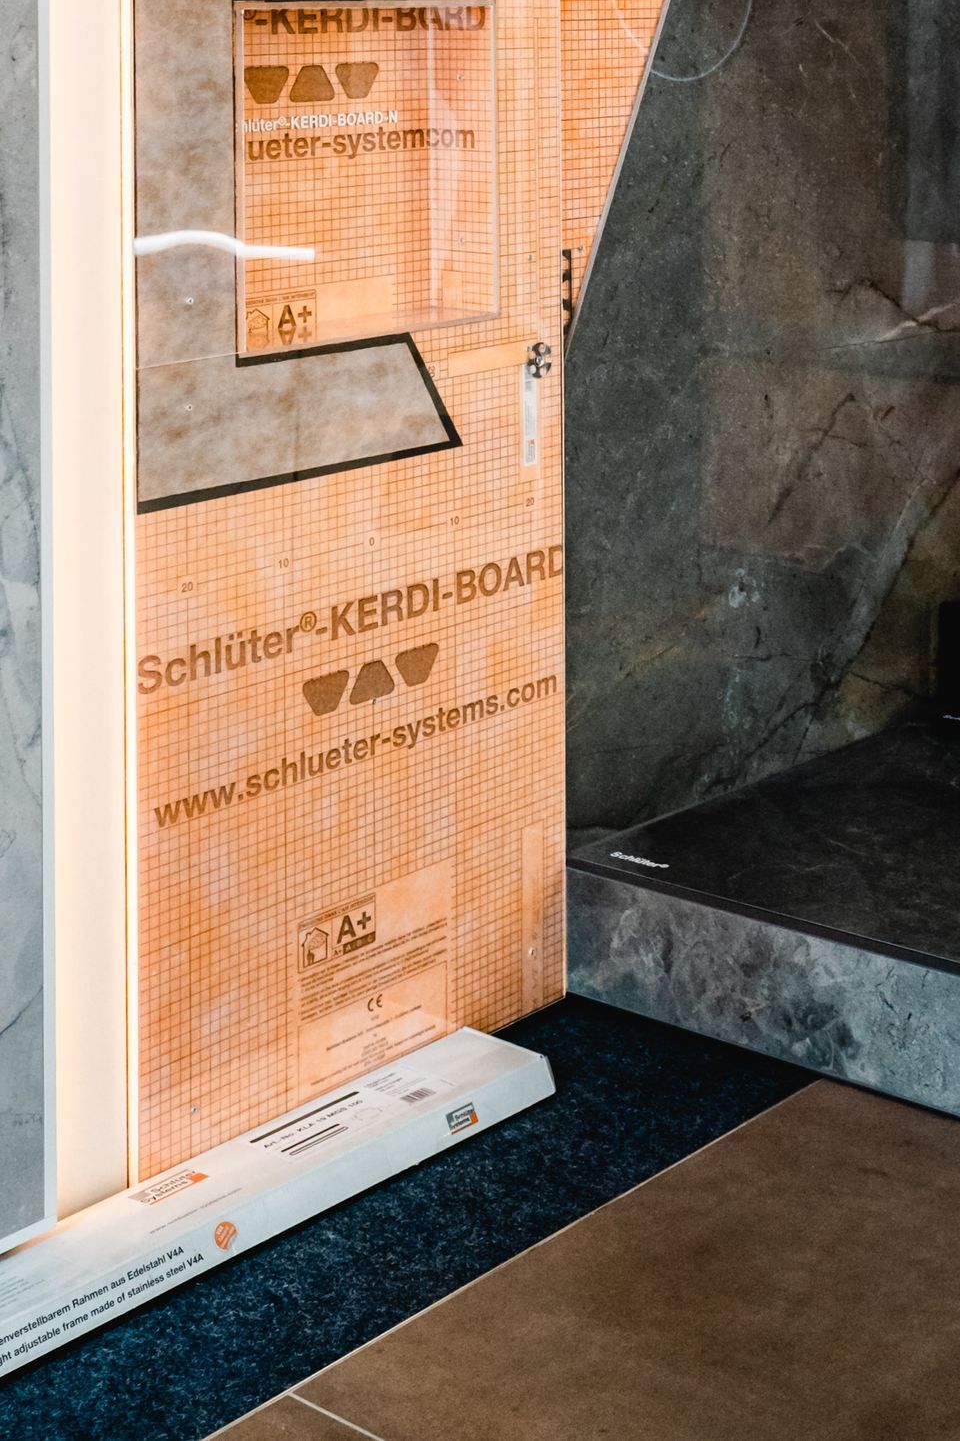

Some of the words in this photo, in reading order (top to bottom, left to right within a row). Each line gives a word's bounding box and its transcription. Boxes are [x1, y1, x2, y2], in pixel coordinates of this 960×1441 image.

[278, 304, 312, 329] A+
[181, 581, 194, 592] 20
[278, 558, 290, 569] 10
[450, 515, 460, 527] 10
[526, 496, 535, 507] 20
[137, 544, 563, 695] Schlüter®-KERDI-BOARD
[154, 674, 558, 828] www.schlueter-systems.com
[337, 911, 372, 945] A+
[0, 1303, 71, 1346] enverstellbarem
[72, 1284, 109, 1310] Rahmen
[111, 1276, 126, 1290] aus
[127, 1256, 166, 1281] Edelstahl
[166, 1245, 185, 1261] V4A
[14, 1326, 61, 1357] adjustable
[63, 1313, 89, 1332] frame
[90, 1301, 115, 1323] made
[117, 1293, 126, 1304] of
[127, 1274, 165, 1299] stainless
[166, 1263, 187, 1281] steel
[186, 1253, 205, 1268] V4A
